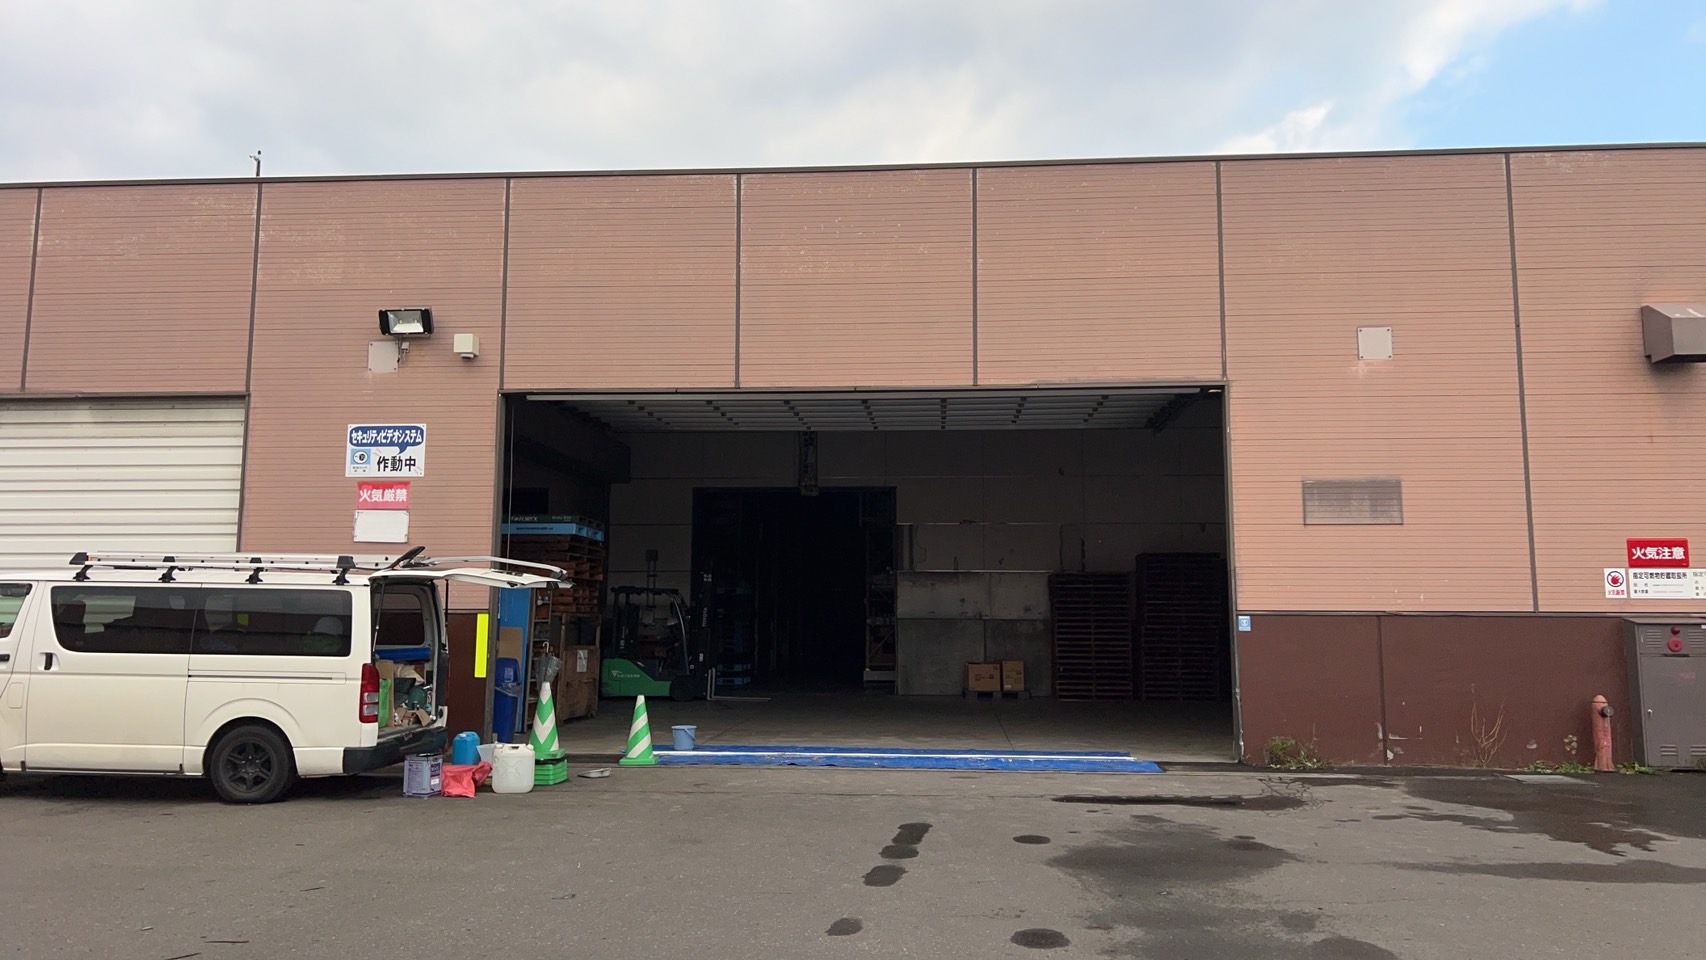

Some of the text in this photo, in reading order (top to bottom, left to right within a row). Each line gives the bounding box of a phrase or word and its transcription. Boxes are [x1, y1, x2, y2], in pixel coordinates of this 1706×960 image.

[351, 428, 422, 444] セキュリティビデオシステム
[377, 455, 416, 472] 作動中
[359, 488, 408, 502] 火気厳禁
[1632, 546, 1685, 560] 火気注意
